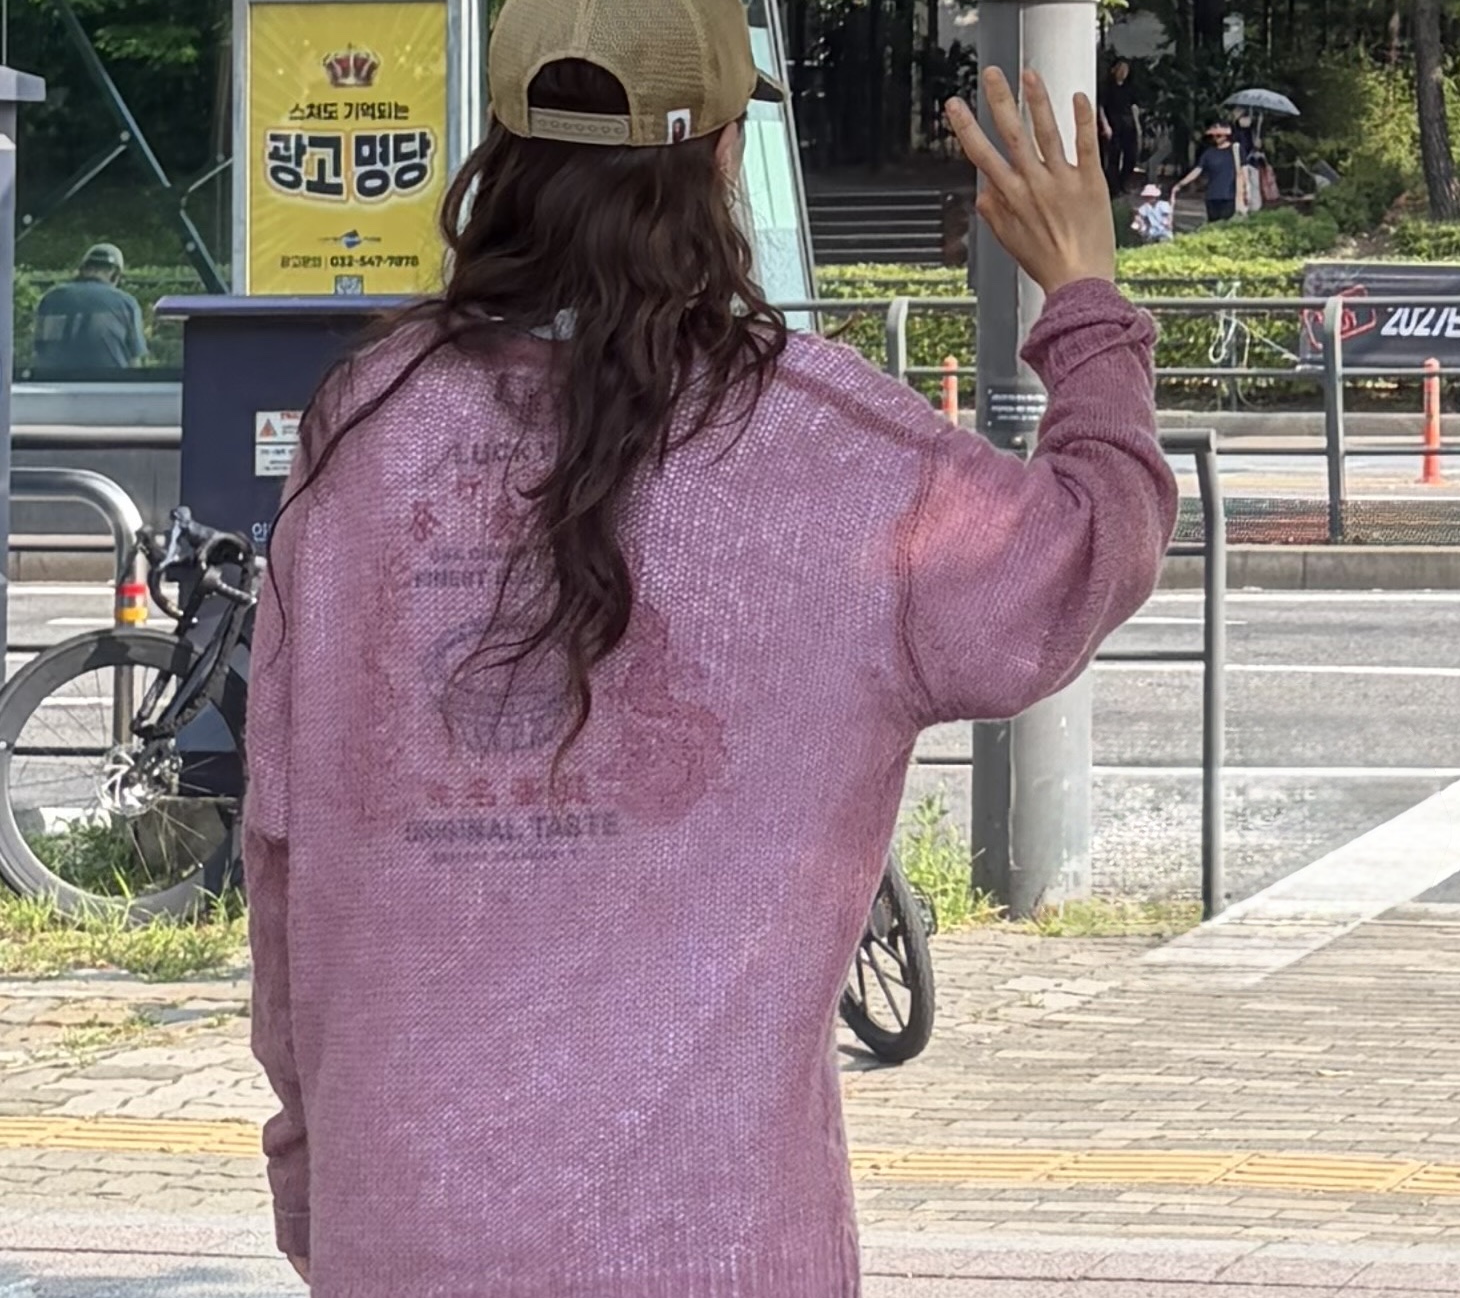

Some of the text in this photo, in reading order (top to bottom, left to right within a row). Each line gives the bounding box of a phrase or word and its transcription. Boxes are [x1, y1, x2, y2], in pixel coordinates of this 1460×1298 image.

[344, 101, 410, 121] 기억되는
[267, 131, 432, 198] 광고 명당
